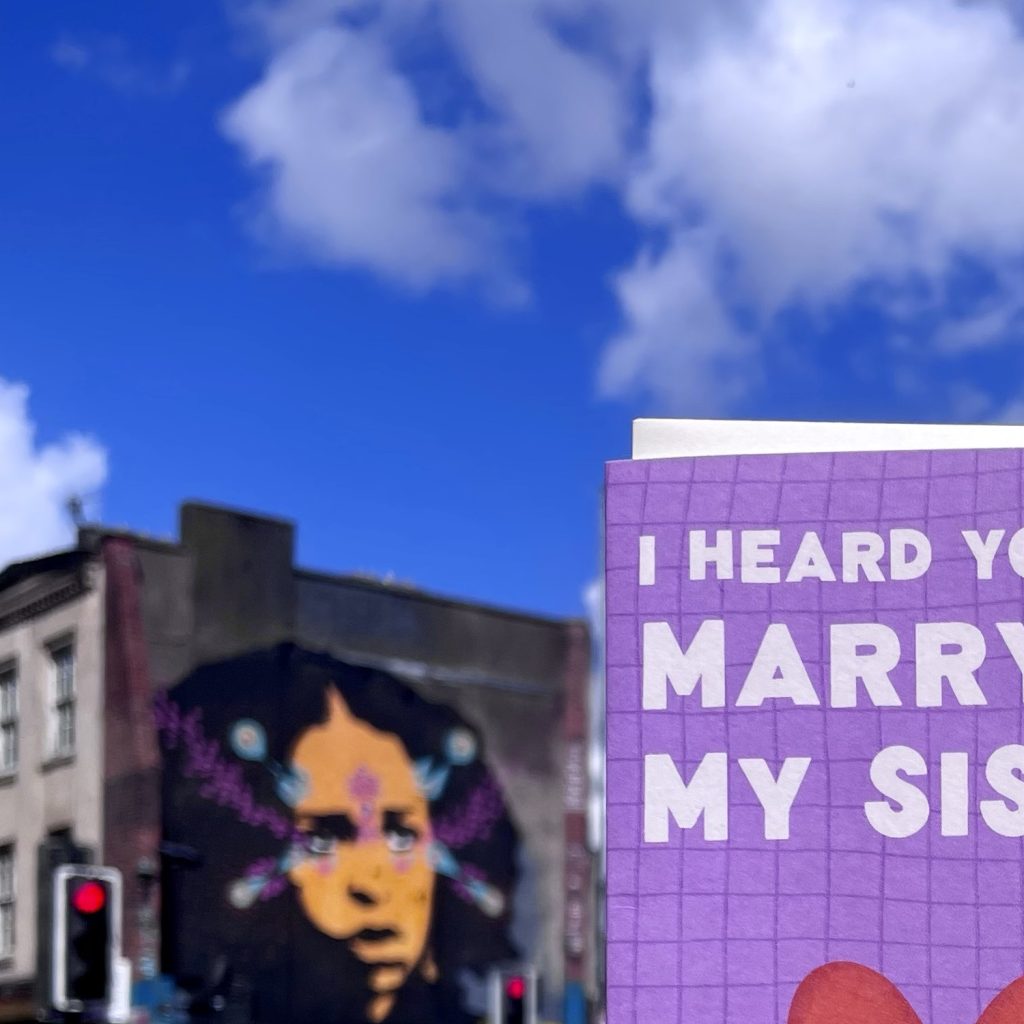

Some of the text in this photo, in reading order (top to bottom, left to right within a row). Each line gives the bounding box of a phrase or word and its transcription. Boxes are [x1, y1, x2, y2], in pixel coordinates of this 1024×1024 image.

[639, 535, 656, 586] I
[689, 528, 933, 583] HEARD
[644, 752, 812, 843] MY
